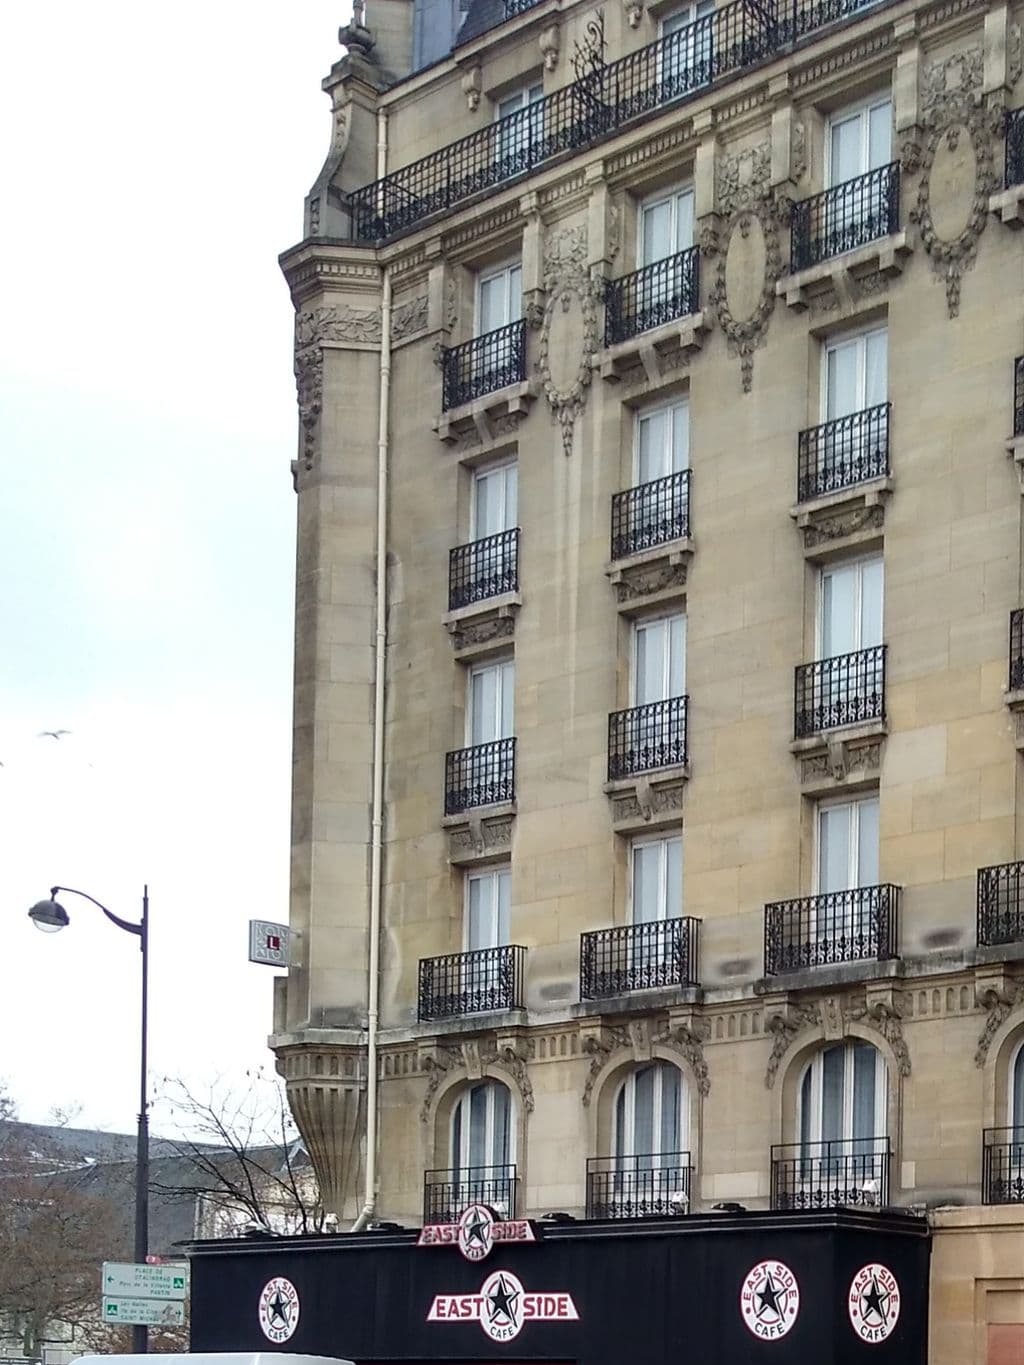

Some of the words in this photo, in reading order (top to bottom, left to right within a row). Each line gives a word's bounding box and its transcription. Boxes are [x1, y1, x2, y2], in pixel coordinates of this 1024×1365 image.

[423, 1226, 462, 1243] EAST
[490, 1223, 528, 1240] SIDE
[743, 1264, 769, 1301] EAST
[774, 1265, 797, 1300] SIDE
[850, 1267, 874, 1304] EAST
[878, 1269, 899, 1303] SIDE
[261, 1280, 278, 1312] EAST
[282, 1282, 298, 1309] SIDE
[436, 1297, 485, 1318] EAST
[523, 1296, 569, 1317] SIDE
[268, 1328, 289, 1341] CAFE
[490, 1326, 515, 1339] CAFE
[754, 1322, 785, 1337] CAFE
[859, 1325, 887, 1341] CAFE
